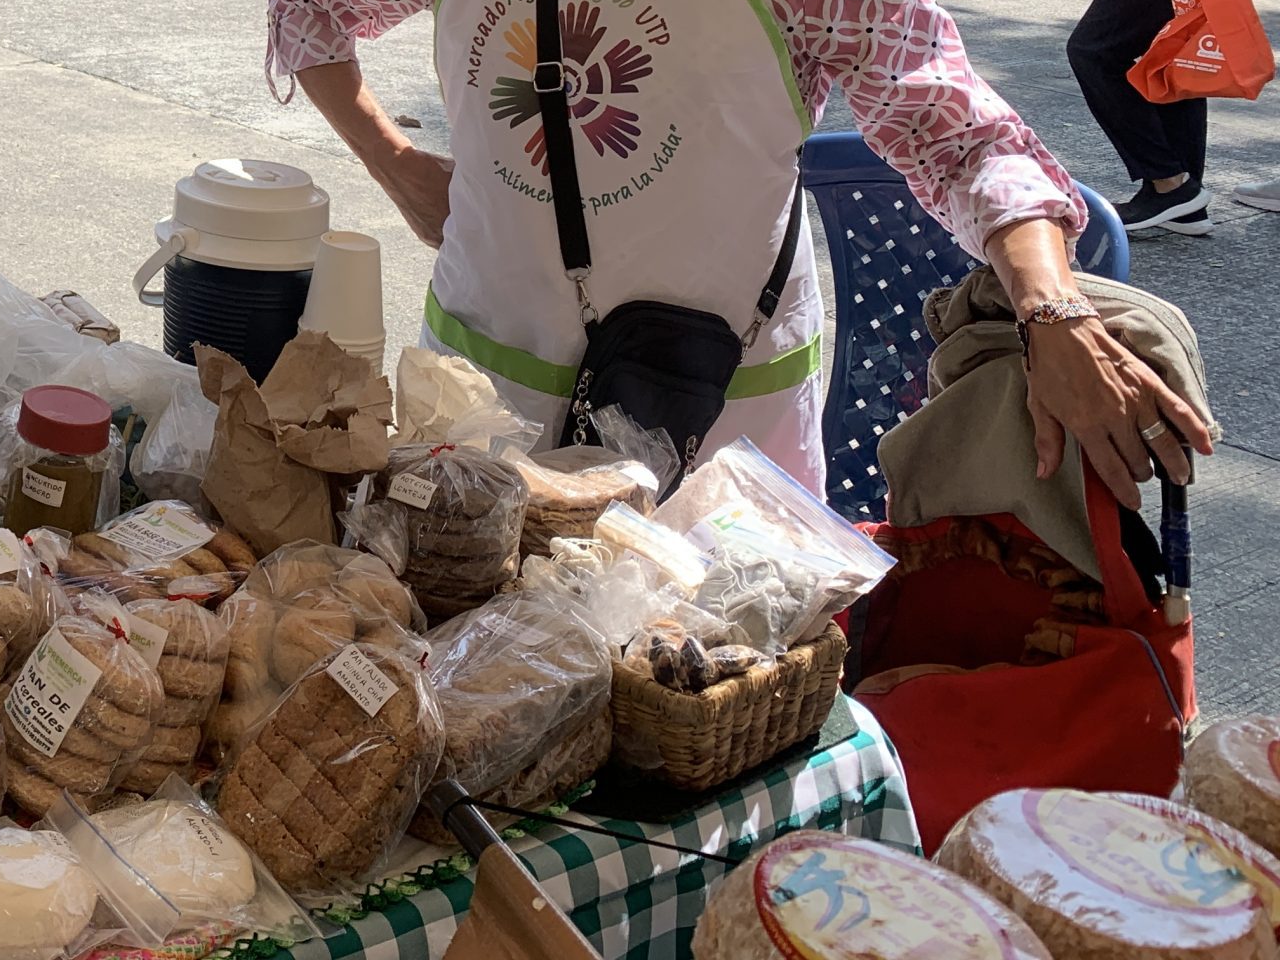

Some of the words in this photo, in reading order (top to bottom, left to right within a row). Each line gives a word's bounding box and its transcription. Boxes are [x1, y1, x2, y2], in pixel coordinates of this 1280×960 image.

[467, 0, 507, 88] Mercado
[635, 5, 671, 46] UTP
[589, 184, 633, 216] para
[631, 172, 654, 191] la
[394, 485, 426, 501] LENTEJA
[350, 650, 362, 666] PAN
[27, 665, 46, 691] PAN
[49, 693, 71, 714] DE
[337, 670, 370, 707] AMARANTO
[342, 661, 367, 686] QUINUA
[367, 687, 384, 703] CHIA
[20, 685, 65, 734] cereales
